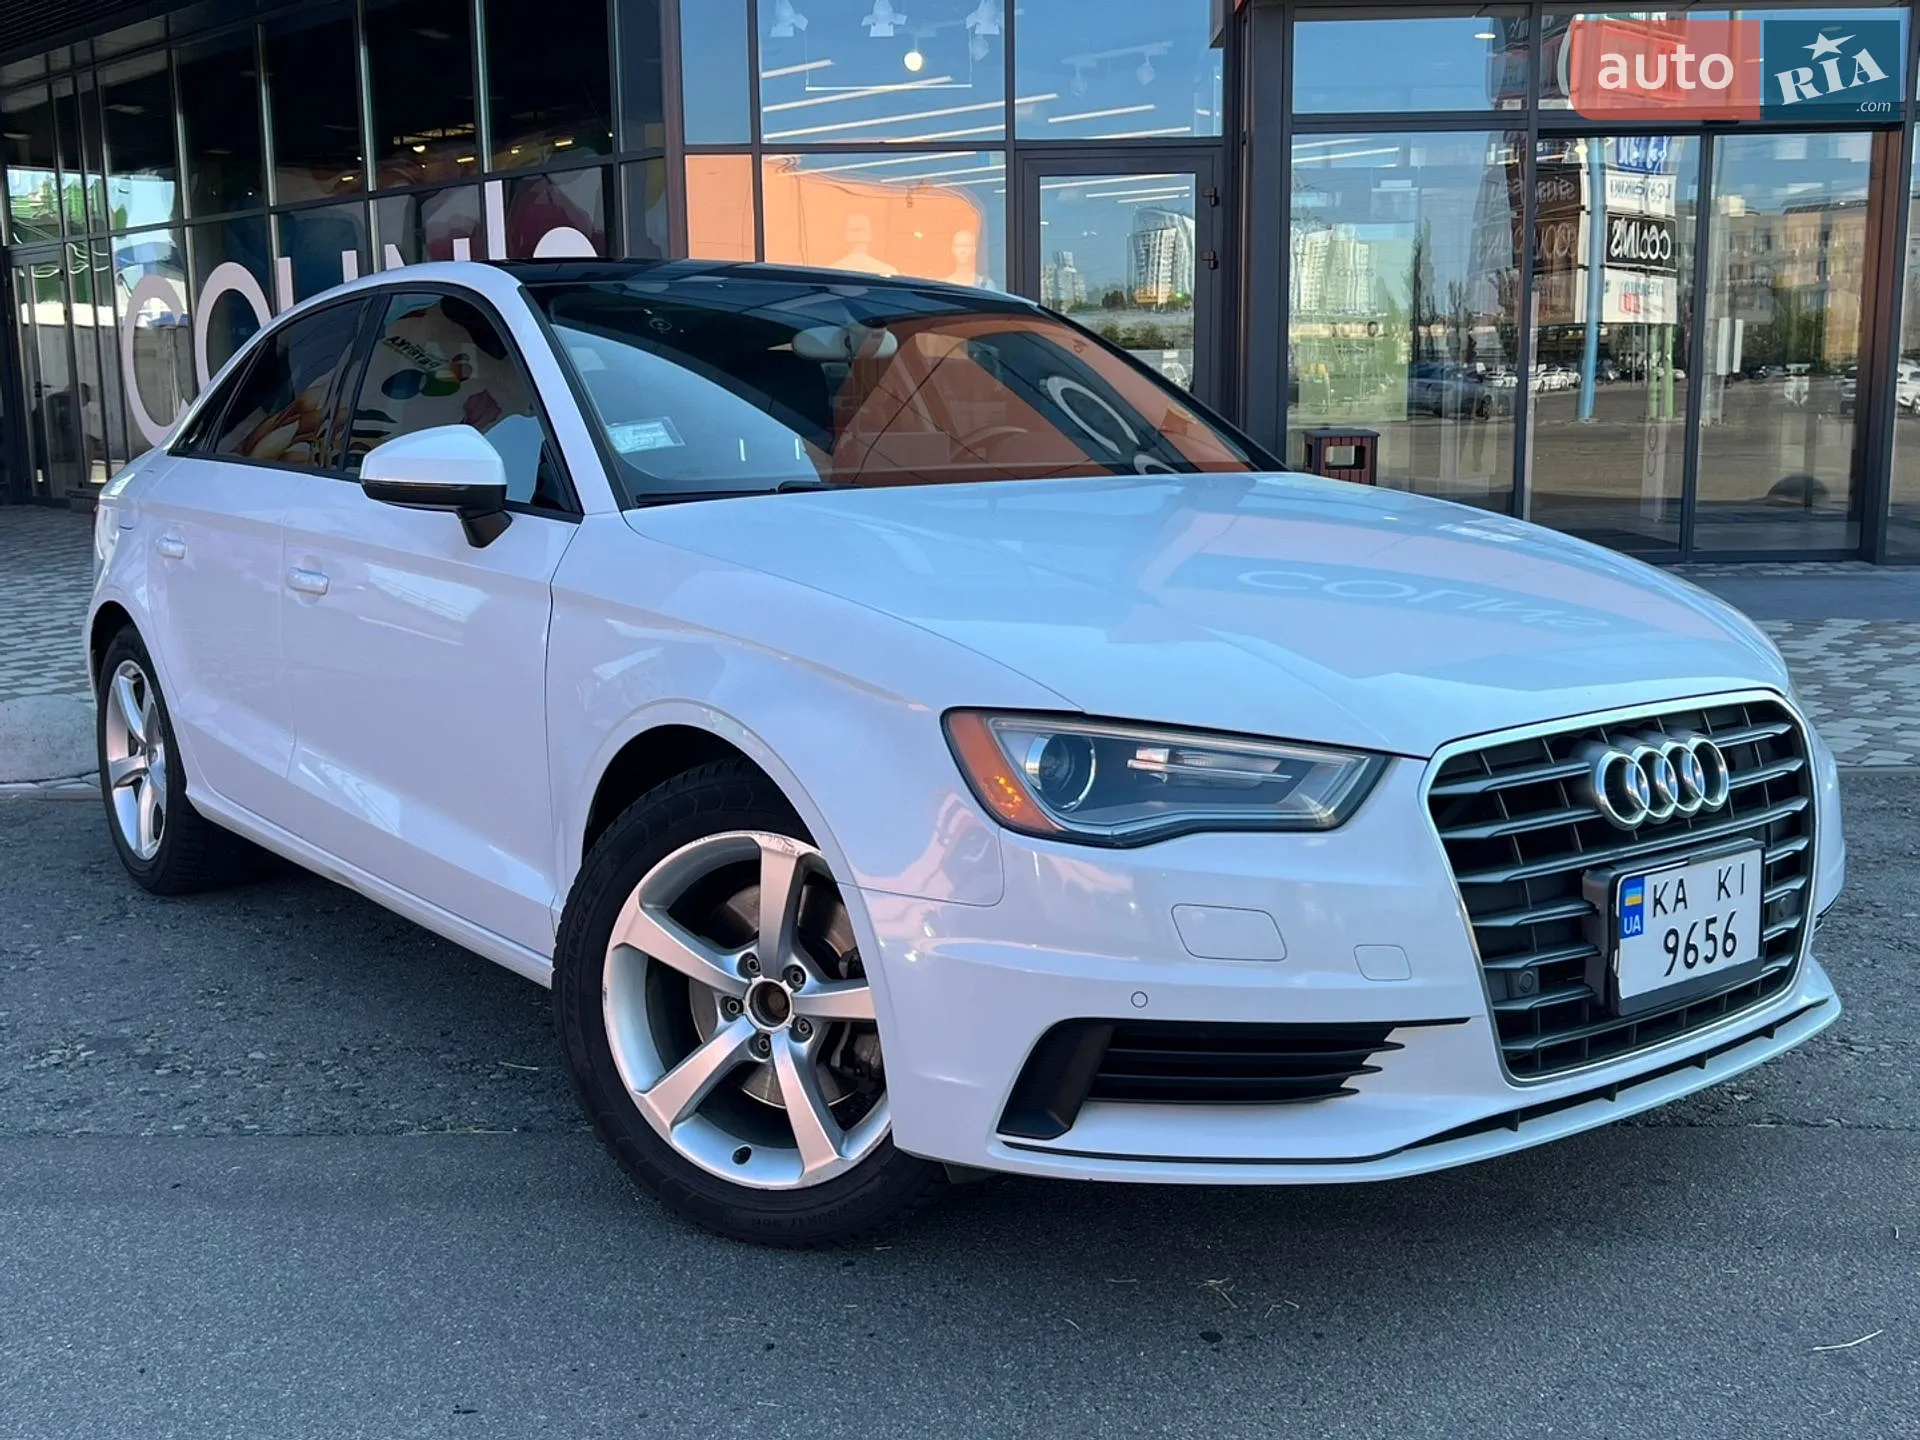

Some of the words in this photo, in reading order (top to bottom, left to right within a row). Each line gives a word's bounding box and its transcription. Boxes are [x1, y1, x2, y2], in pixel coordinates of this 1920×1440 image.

[1652, 878, 1689, 918] KA
[1717, 861, 1746, 902] KI
[1623, 915, 1642, 934] UA
[1662, 909, 1738, 977] 9656
